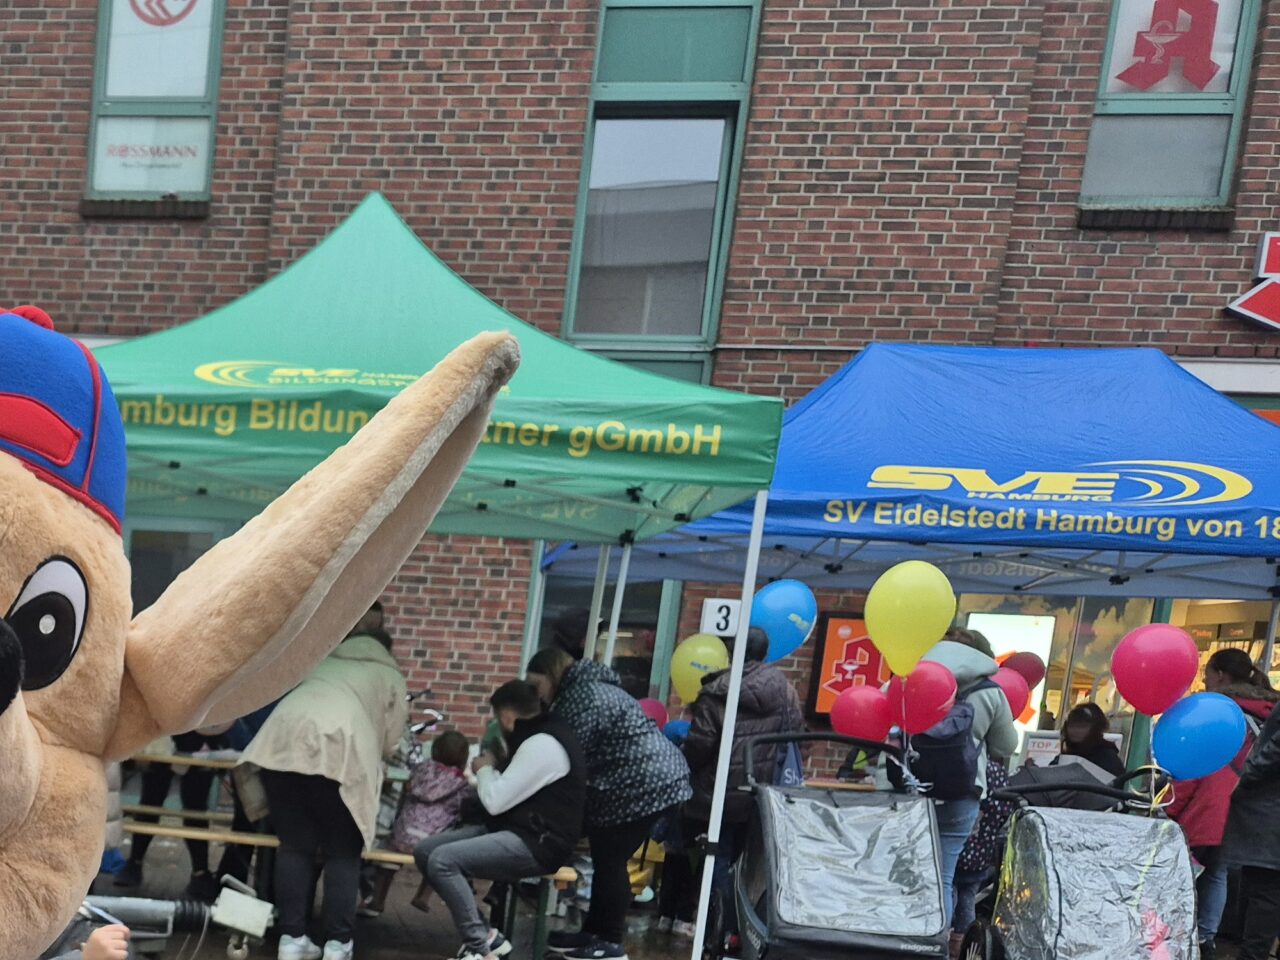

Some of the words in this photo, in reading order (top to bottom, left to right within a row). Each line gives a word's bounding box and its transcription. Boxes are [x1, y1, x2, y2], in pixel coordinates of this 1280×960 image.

[123, 395, 238, 436] mburg
[567, 420, 722, 458] gGmbH
[867, 465, 1120, 495] SVE
[966, 491, 1112, 502] HAMBURG
[823, 500, 868, 524] SV
[872, 502, 1027, 530] Eidelstedt
[1035, 508, 1177, 541] Hamburg
[1186, 517, 1243, 538] von
[716, 605, 731, 631] 3
